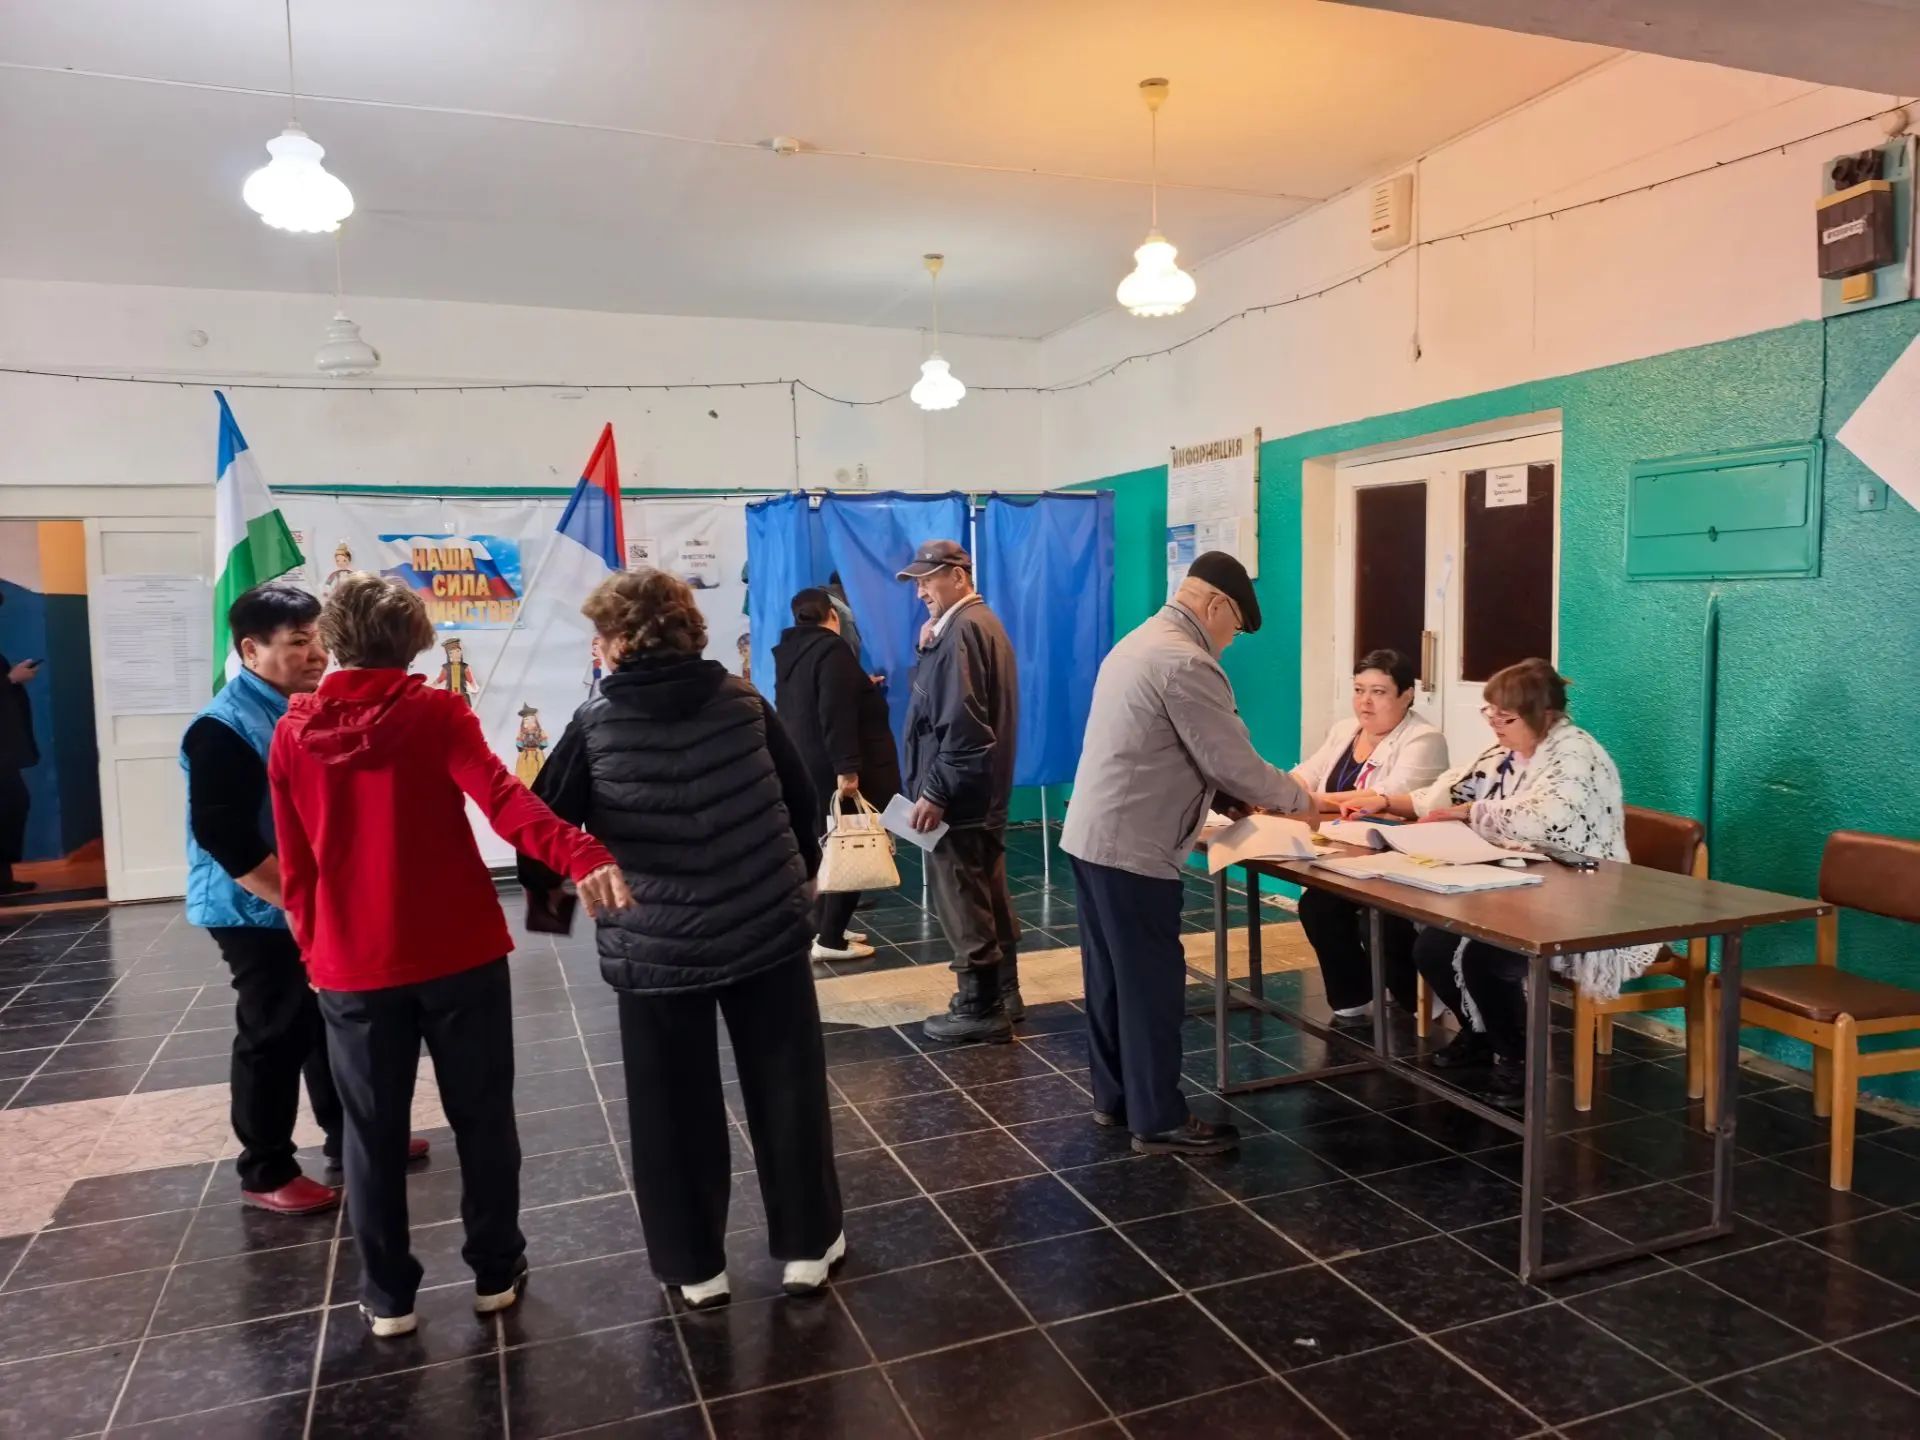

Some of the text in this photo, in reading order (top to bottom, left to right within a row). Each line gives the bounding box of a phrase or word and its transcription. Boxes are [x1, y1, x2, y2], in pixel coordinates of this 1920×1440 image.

[1172, 438, 1243, 469] ИНФОРМАЦИЯ
[412, 548, 476, 571] НАША
[432, 573, 491, 598] СИЛА
